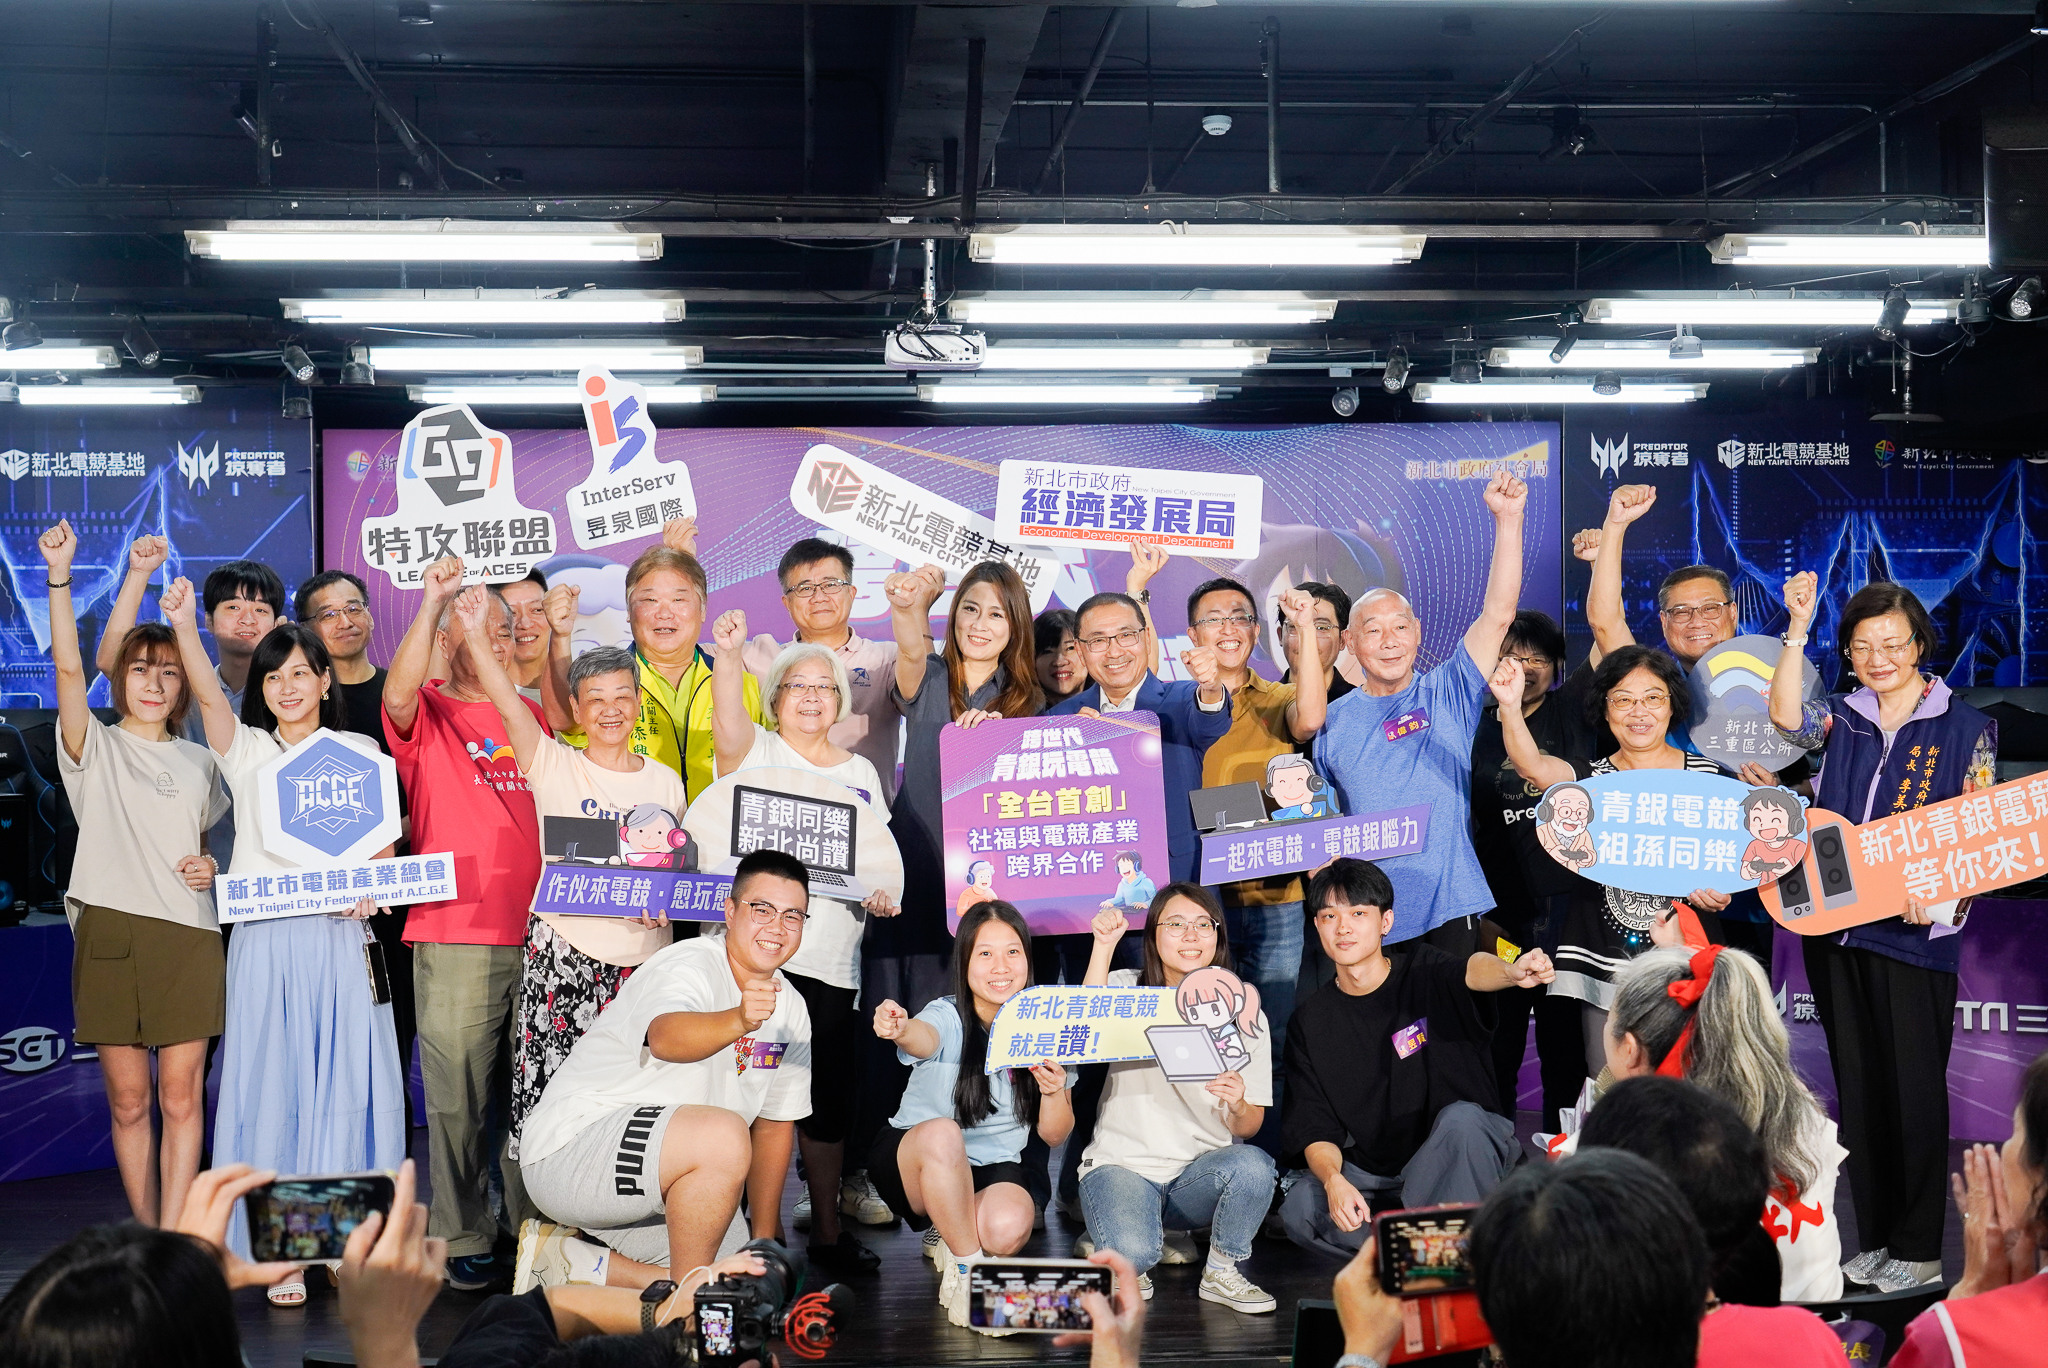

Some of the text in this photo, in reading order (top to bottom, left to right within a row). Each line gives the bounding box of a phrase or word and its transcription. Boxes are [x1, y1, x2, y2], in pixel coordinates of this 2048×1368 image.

[31, 451, 146, 471] 新北電競基地
[225, 452, 285, 460] PREDATOR
[1633, 443, 1689, 451] PREDATOR
[1633, 452, 1689, 468] 掠奪者
[1747, 442, 1850, 460] 新北電競基地
[32, 470, 146, 478] NEW TAIPEI CITY ESPORTS
[225, 460, 286, 478] 掠奪者
[1023, 467, 1132, 492] 新北市政府
[580, 473, 676, 507] InterServ
[1150, 487, 1173, 496] Taipei
[1173, 488, 1189, 496] City
[1189, 490, 1236, 498] Government
[586, 497, 684, 541] 昱泉國際
[1020, 487, 1236, 537] 經濟發展局
[367, 516, 553, 566] 特攻聯盟
[855, 511, 970, 570] NEW TAIPEI CITY
[860, 483, 1042, 589] 新北電競基地
[1022, 526, 1232, 549] Economic Development Department
[480, 562, 527, 577] ACES
[1020, 726, 1086, 751] 跨世代
[1724, 718, 1776, 738] 新北市
[1705, 736, 1794, 757] 三重區公所
[1903, 745, 1922, 772] 局長
[990, 747, 1121, 783] 青銀玩電競
[292, 772, 366, 817] ACGE
[982, 784, 1128, 820] 「全台首創」
[740, 792, 851, 838] 青銀同樂
[1600, 789, 1741, 832] 青銀電競
[737, 823, 850, 870] 新北尚讚
[968, 818, 1140, 853] 社福與電競產業
[1006, 849, 1105, 879] 跨界合作
[1597, 830, 1738, 873] 祖孫同樂
[226, 858, 446, 901] 新北市電競產業總會
[228, 884, 449, 916] New Taipei City Federation of A.C.G.E
[1015, 993, 1160, 1021] 新北青銀電競
[614, 1105, 667, 1197] PUMA
